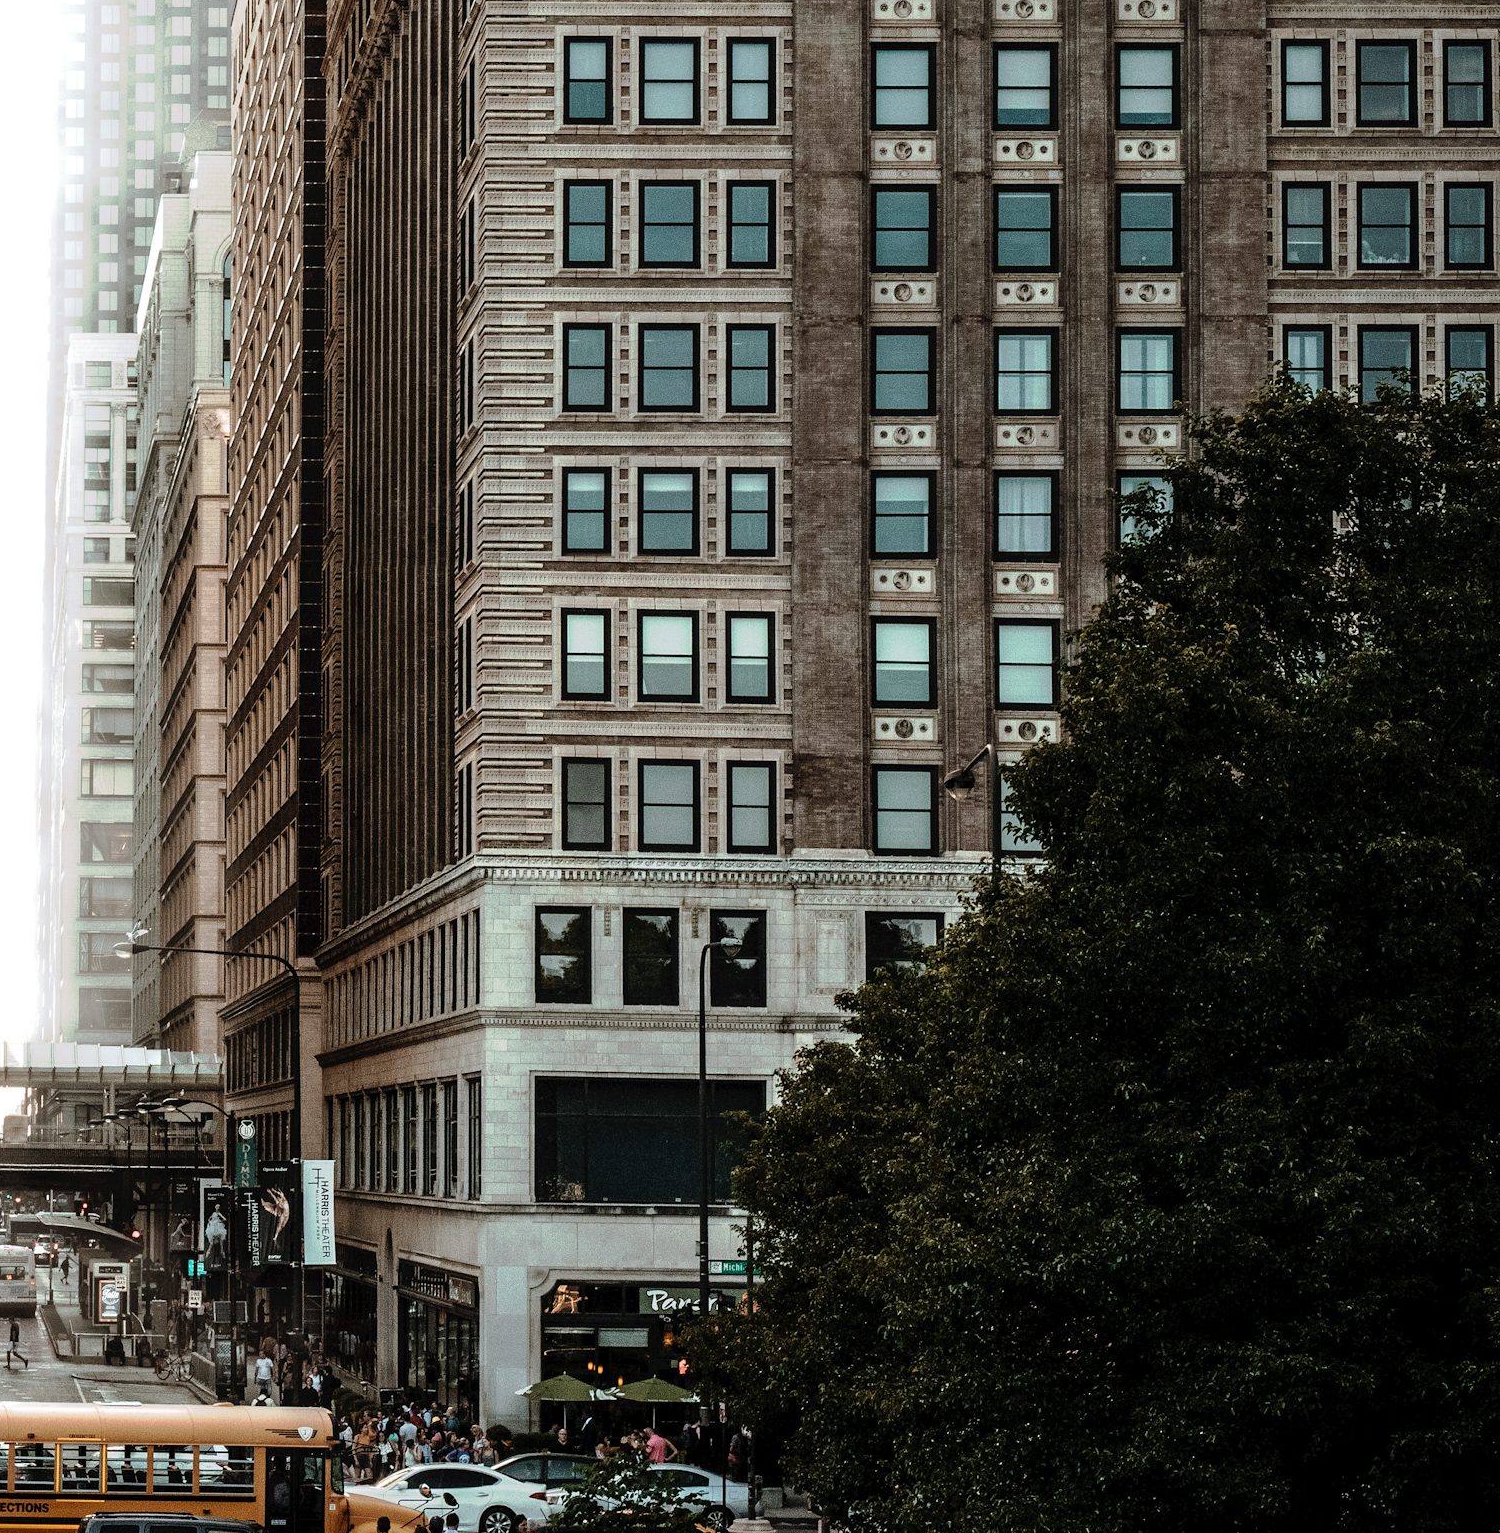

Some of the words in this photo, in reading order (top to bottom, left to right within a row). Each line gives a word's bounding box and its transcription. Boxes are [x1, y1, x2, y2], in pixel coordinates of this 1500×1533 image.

[321, 1181, 329, 1216] HARRIS
[251, 1203, 259, 1232] HARRIS
[252, 1233, 260, 1266] THEATER
[322, 1218, 331, 1258] THEATER
[723, 1263, 747, 1272] Michi
[647, 1290, 731, 1311] Panr
